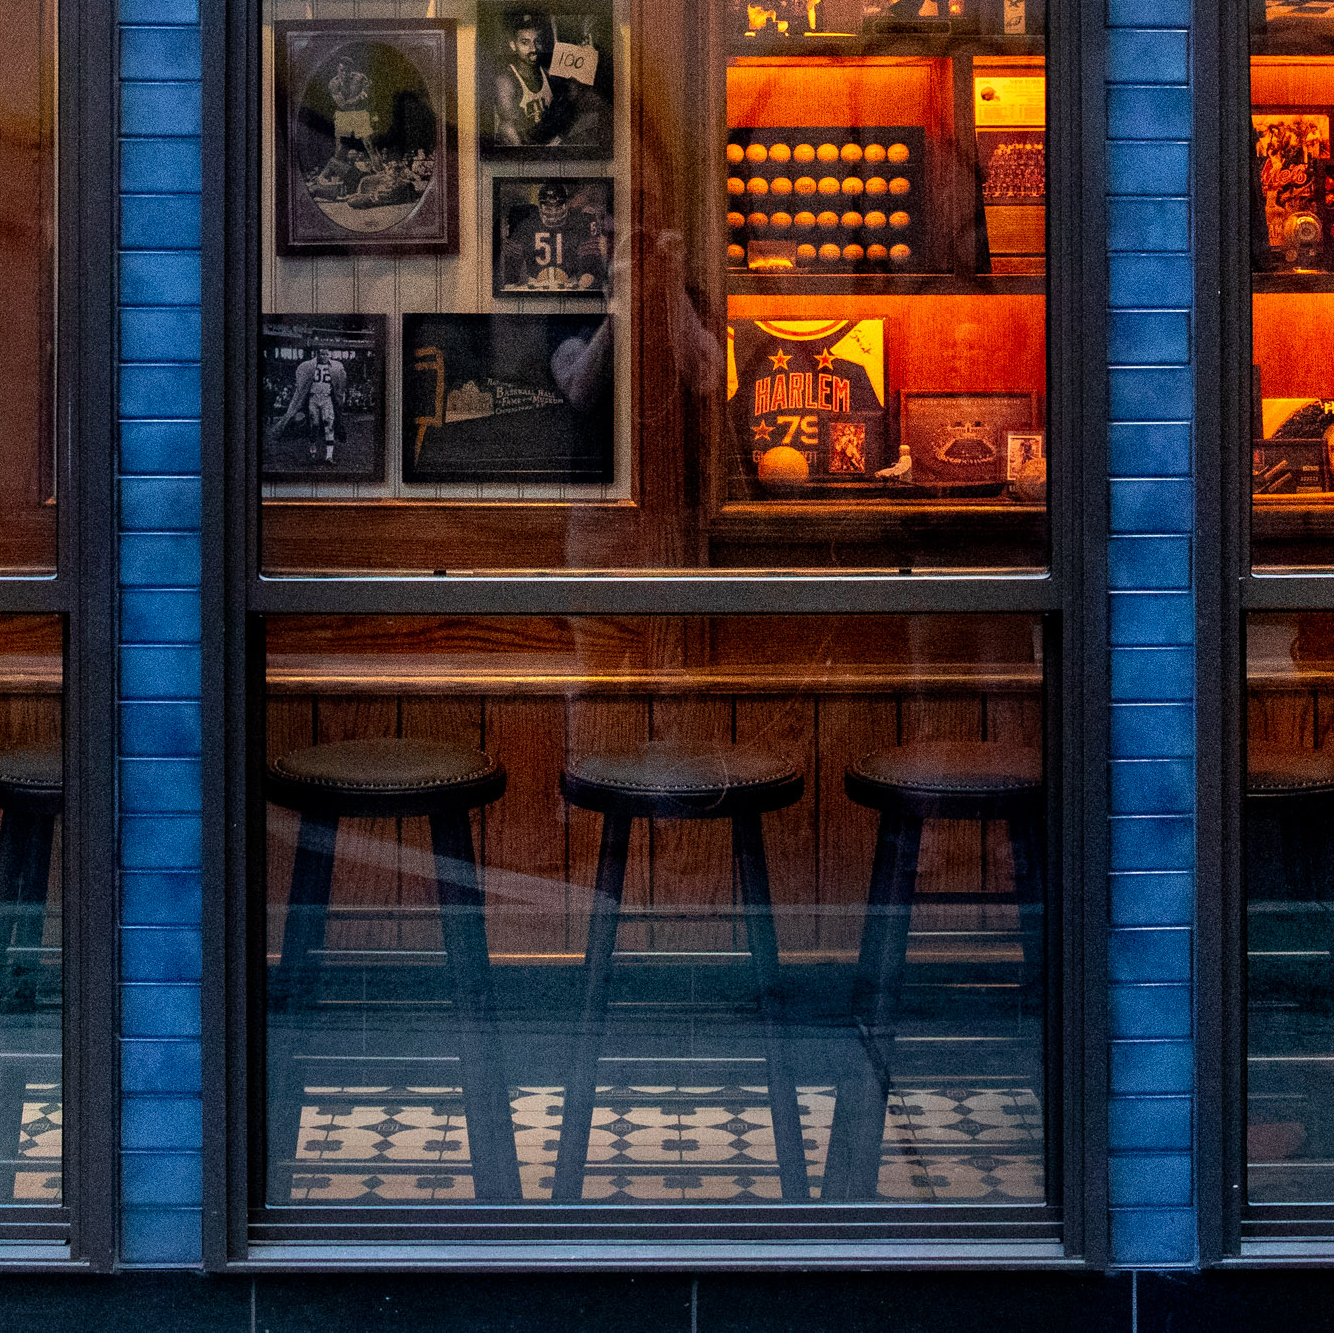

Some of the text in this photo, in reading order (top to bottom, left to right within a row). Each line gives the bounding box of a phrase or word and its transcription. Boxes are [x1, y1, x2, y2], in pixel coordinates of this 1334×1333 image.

[558, 52, 585, 69] 100
[534, 231, 564, 266] 51
[754, 372, 851, 416] HARLEM
